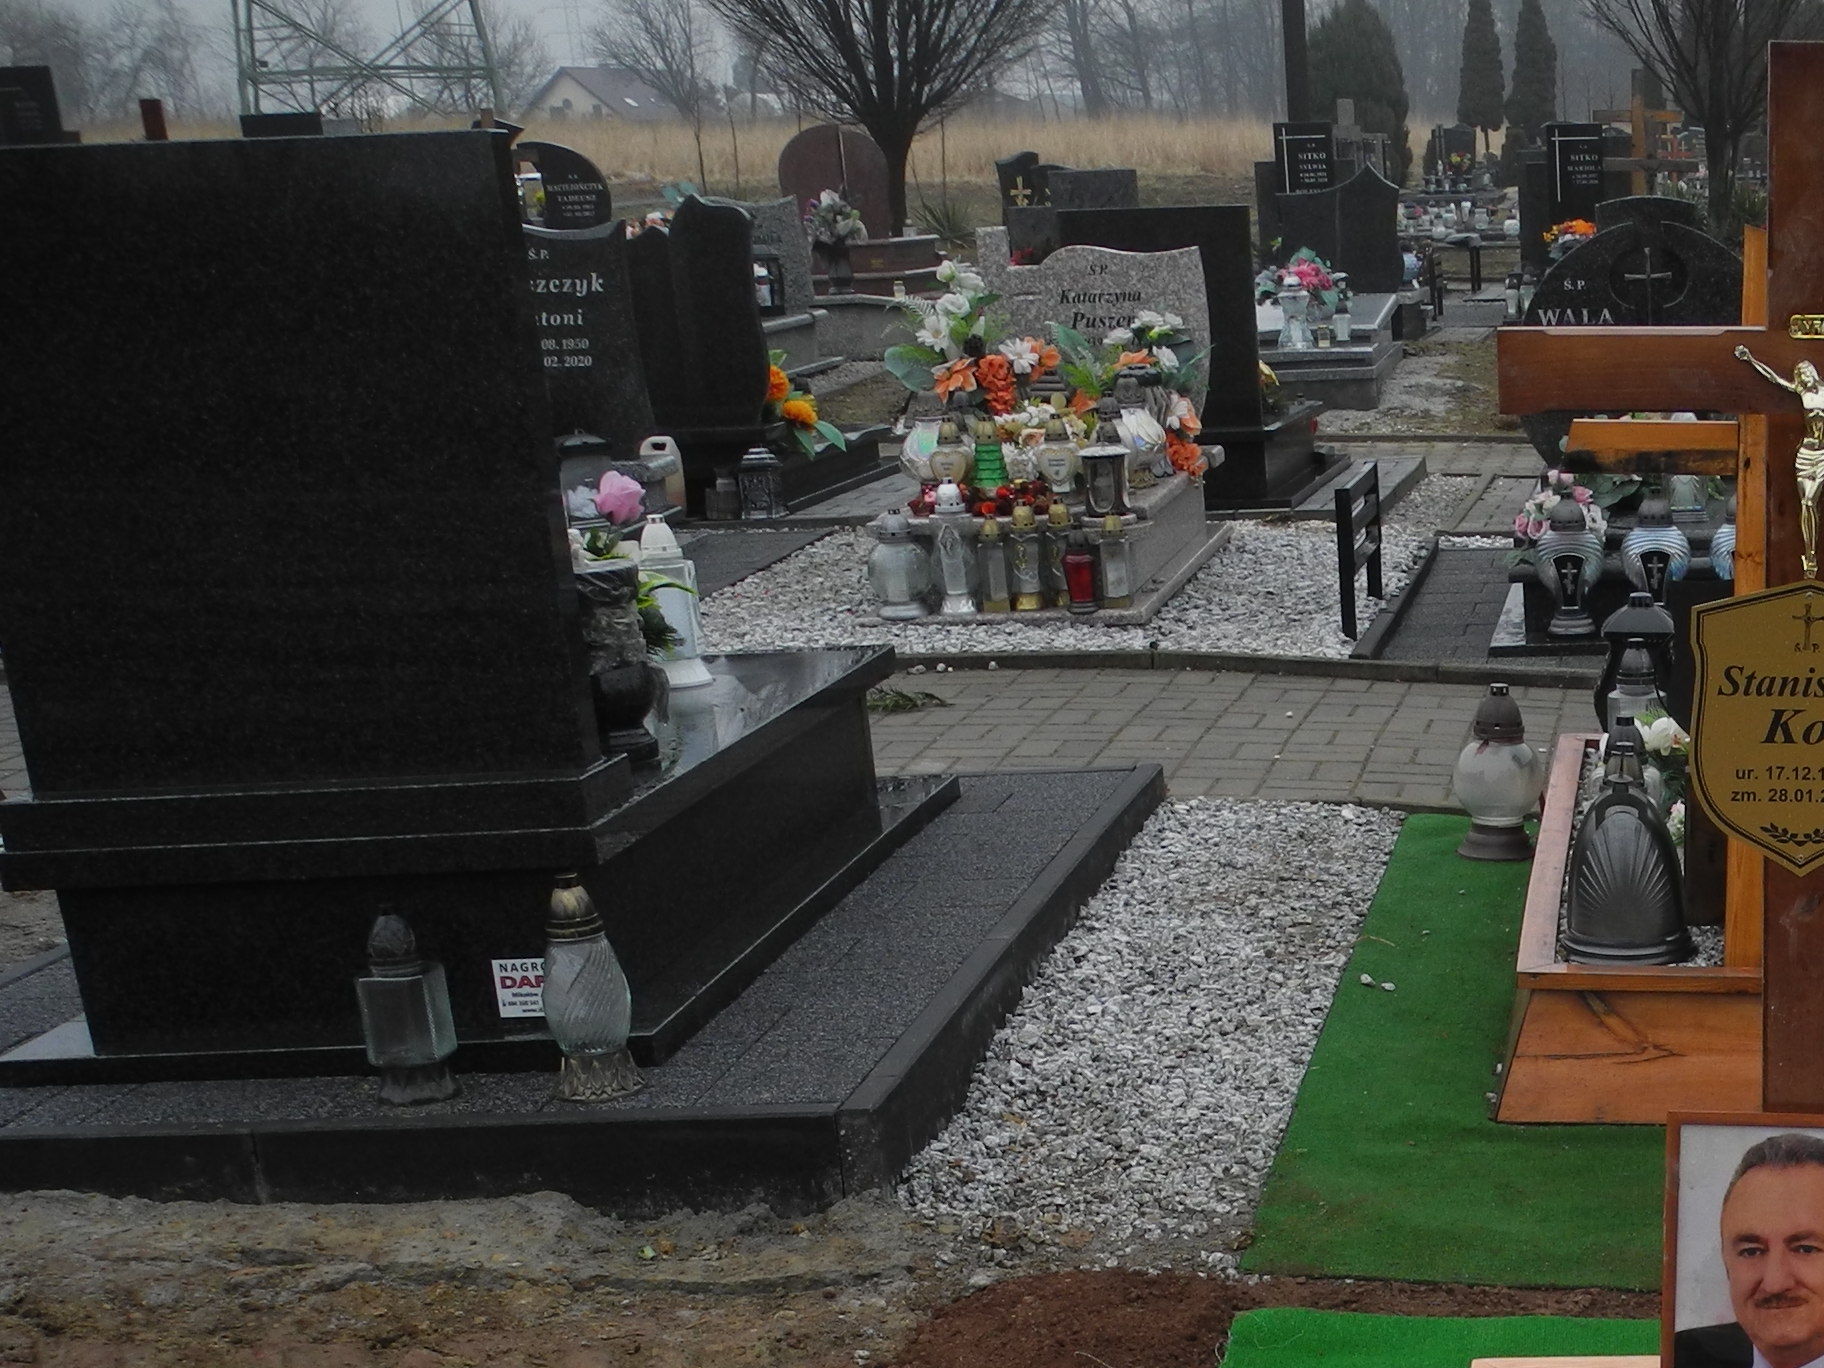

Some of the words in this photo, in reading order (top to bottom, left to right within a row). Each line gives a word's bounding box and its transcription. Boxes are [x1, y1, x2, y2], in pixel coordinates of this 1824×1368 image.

[1298, 152, 1327, 160] SITKO
[1060, 288, 1142, 306] Katarzyna
[535, 308, 584, 326] toni
[1537, 307, 1615, 326] WALA
[1735, 768, 1759, 781] ur.
[1731, 791, 1762, 803] zm.
